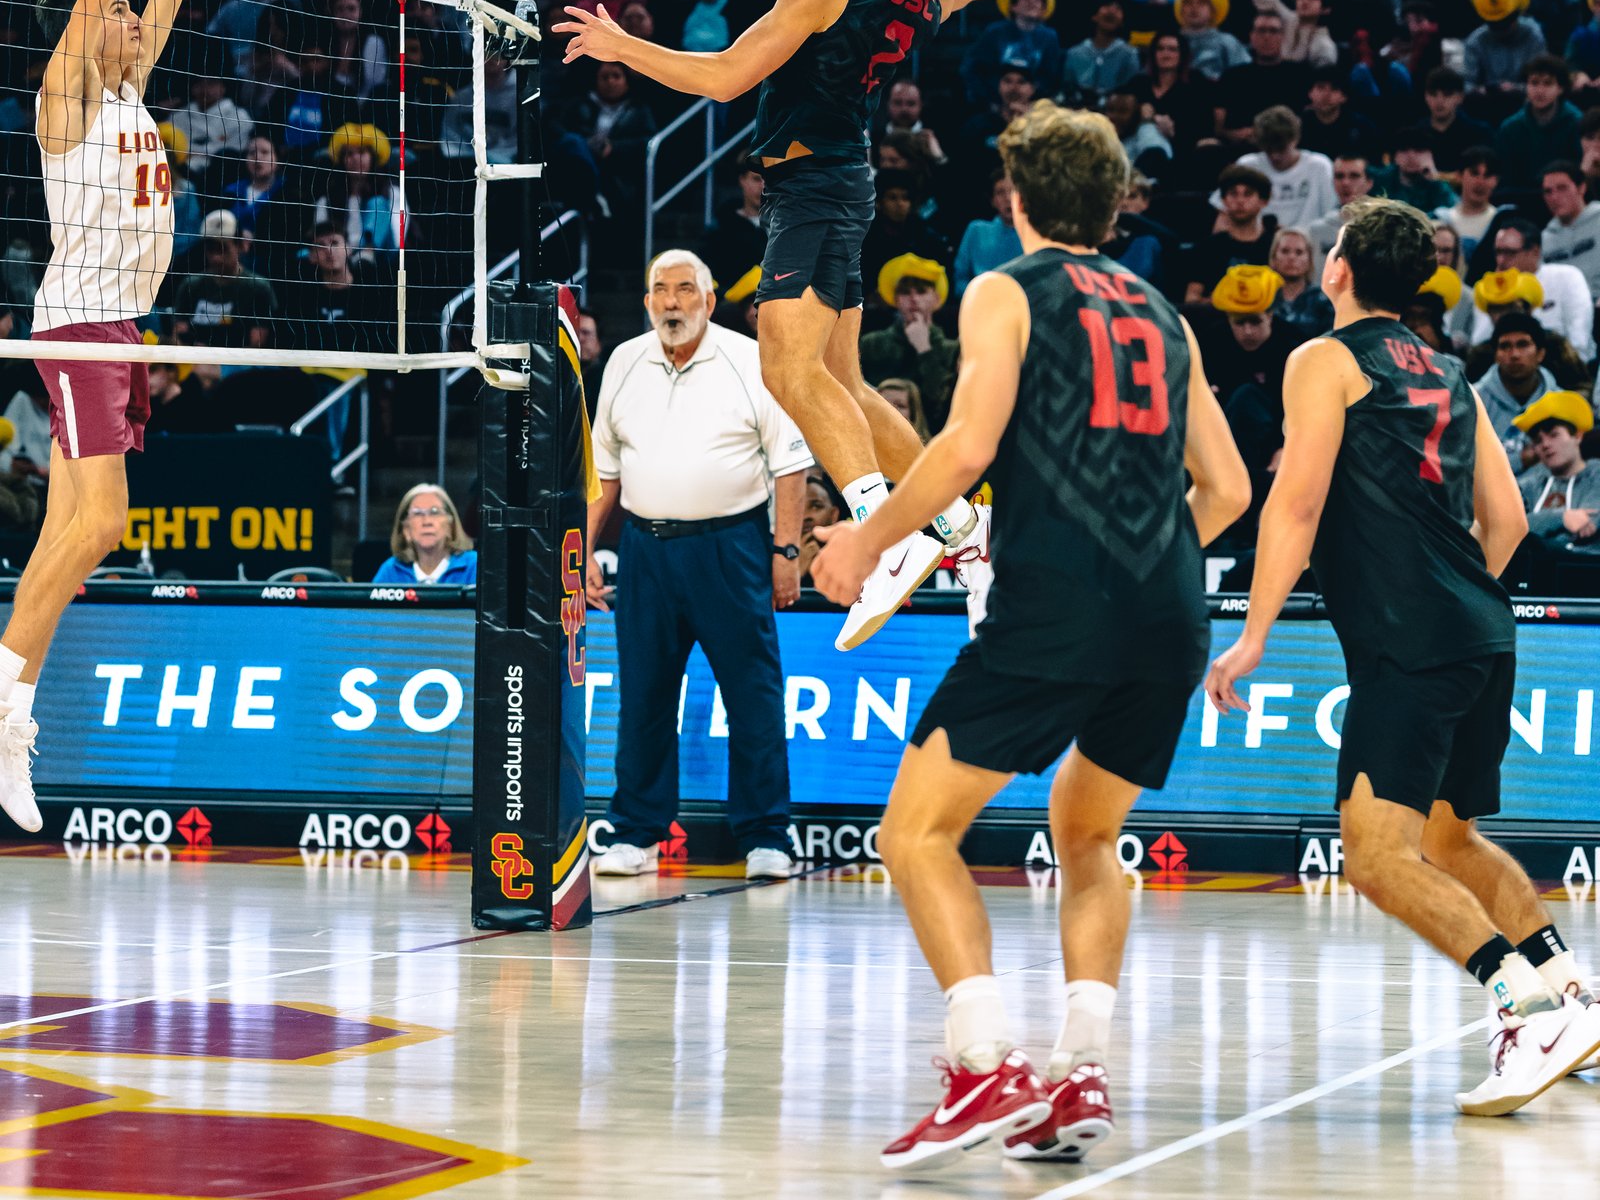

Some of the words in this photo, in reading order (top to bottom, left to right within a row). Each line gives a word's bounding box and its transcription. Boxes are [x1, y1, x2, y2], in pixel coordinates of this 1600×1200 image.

[118, 128, 164, 153] LIO
[132, 162, 171, 207] 19
[1063, 263, 1147, 304] USC
[1078, 308, 1170, 436] 13
[1383, 338, 1445, 376] USC
[1407, 386, 1452, 484] 7
[230, 506, 313, 551] ON!
[152, 585, 186, 598] ARCO
[261, 586, 296, 600] ARCO
[370, 588, 405, 601] ARCO
[1220, 599, 1250, 611] ARC
[95, 663, 282, 730] THE
[504, 665, 525, 734] sports
[503, 737, 524, 821] imports
[63, 807, 172, 843] ARCO
[299, 813, 412, 850] ARCO
